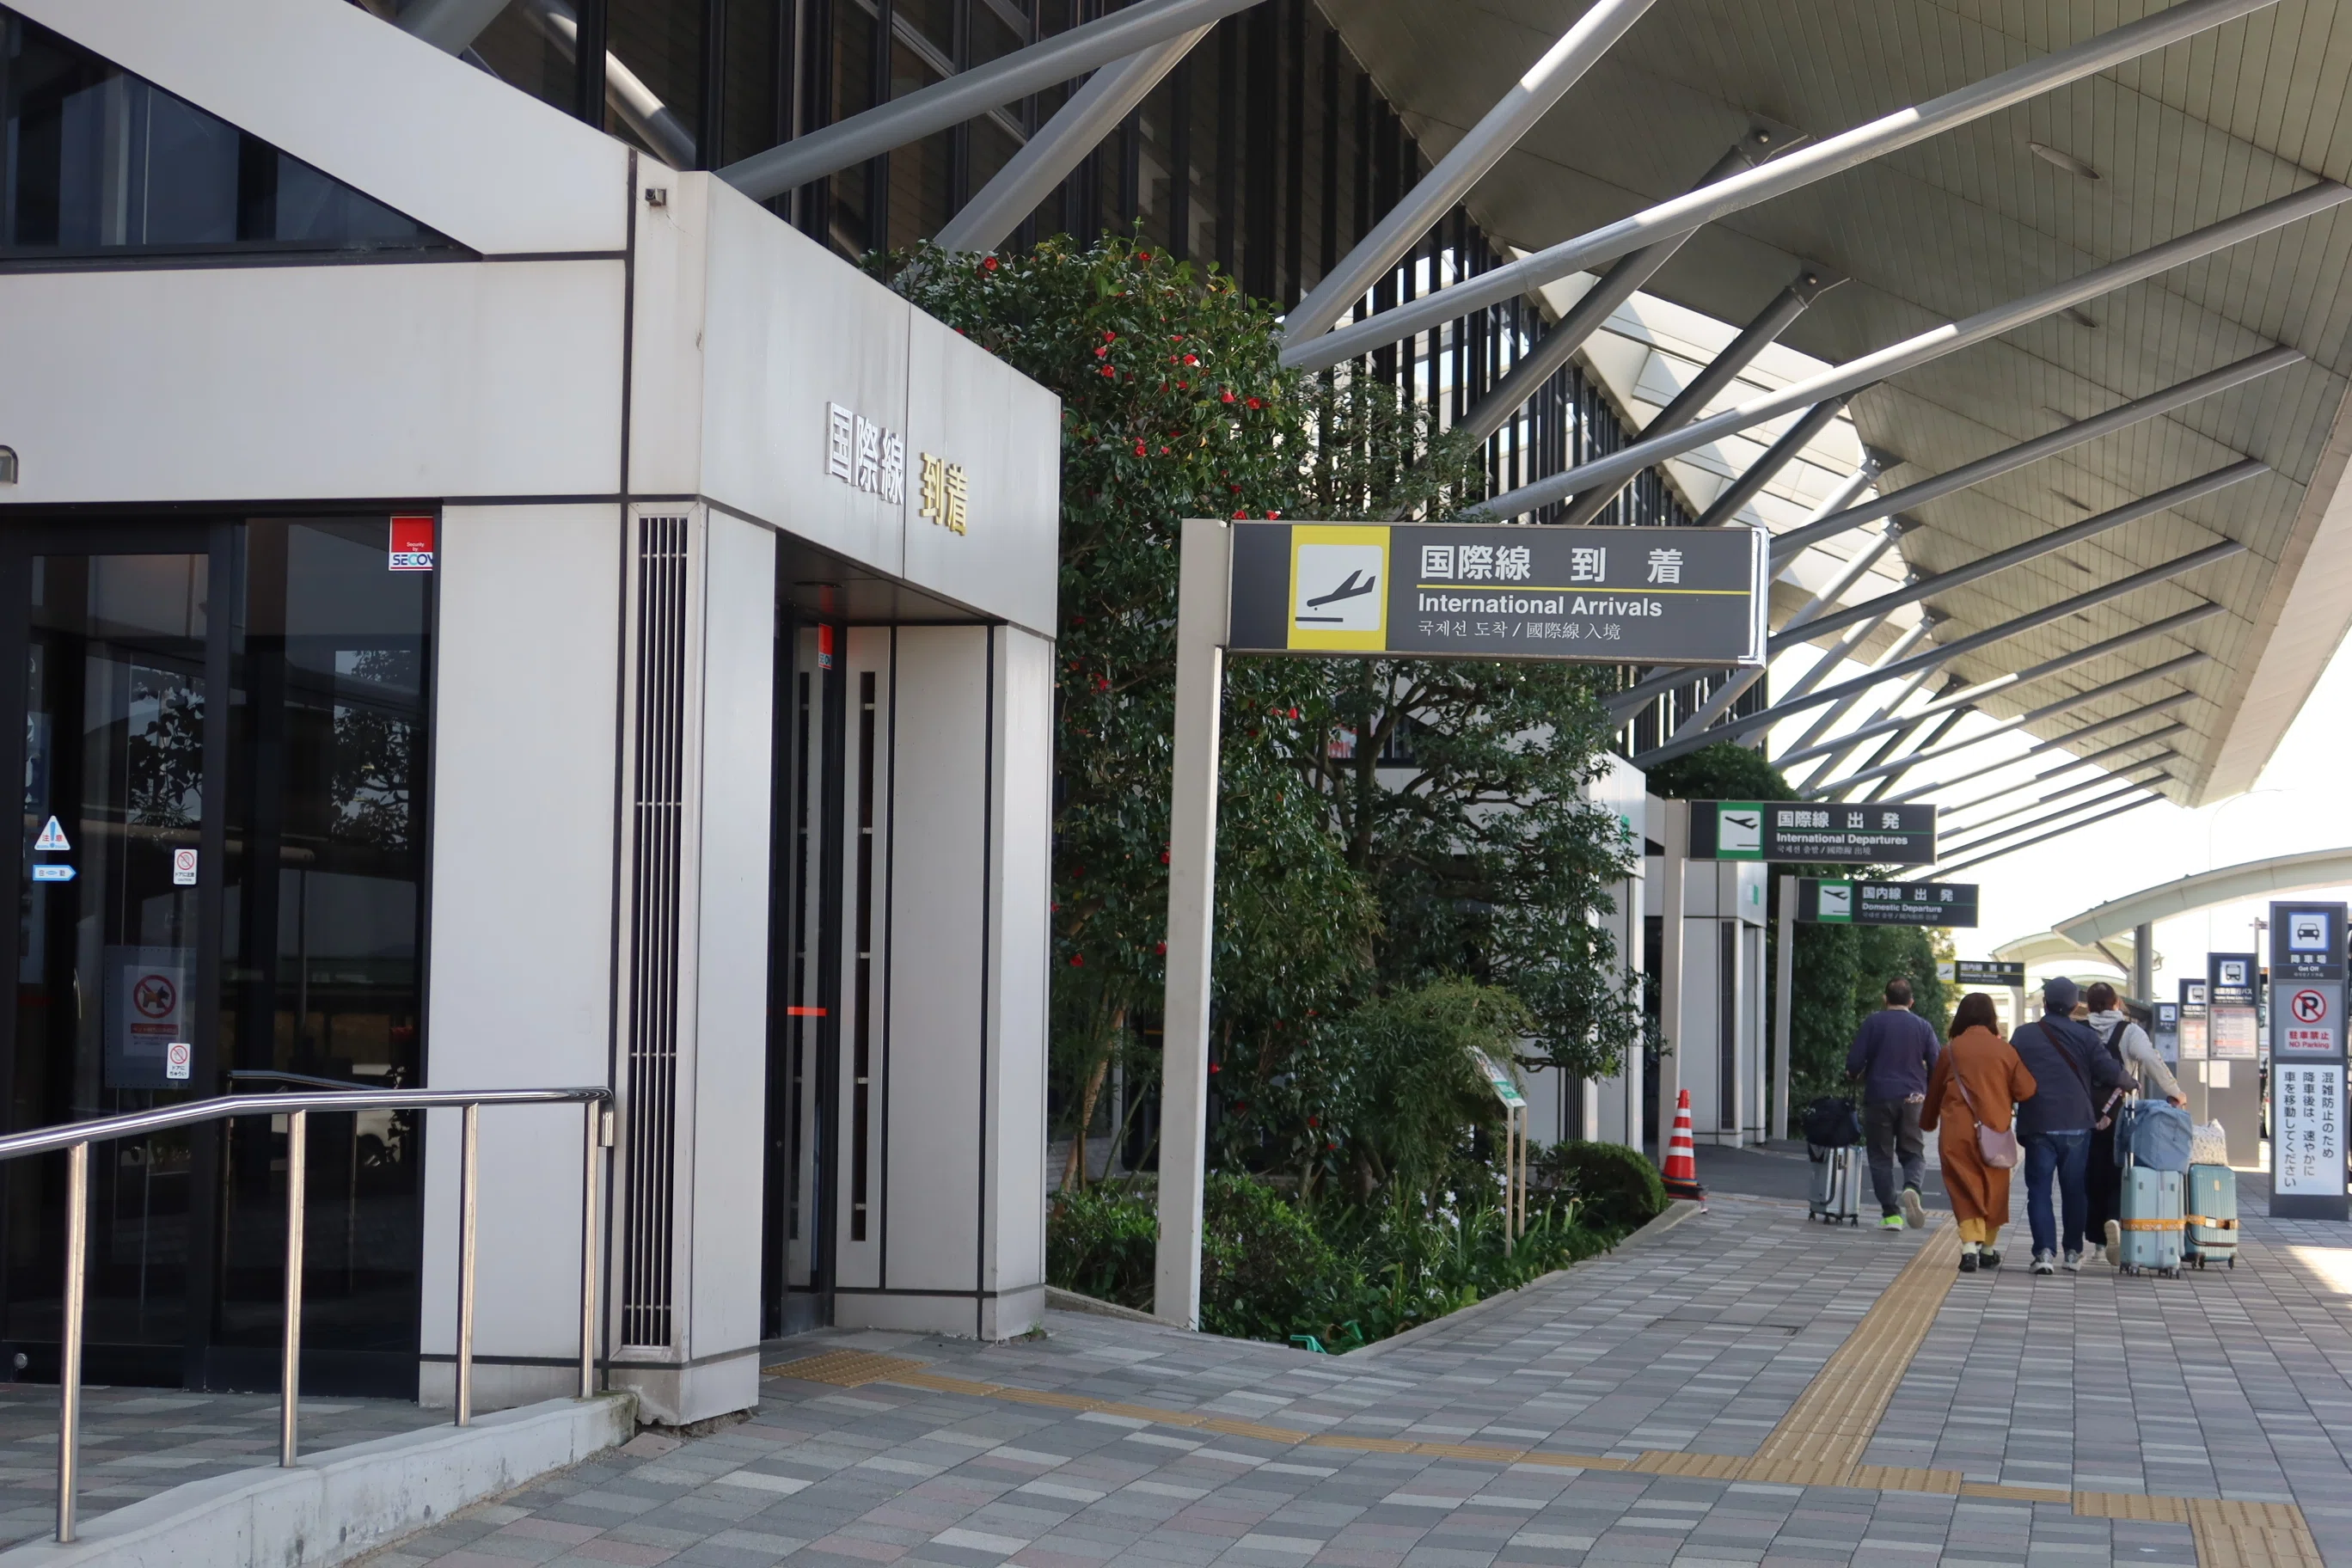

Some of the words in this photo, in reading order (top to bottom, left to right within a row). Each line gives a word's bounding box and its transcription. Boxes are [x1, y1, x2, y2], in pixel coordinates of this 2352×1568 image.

[825, 401, 903, 505] 国際線
[919, 452, 968, 536] 到着
[1420, 545, 1531, 581] 国際線
[1418, 593, 1565, 615] International
[1571, 596, 1663, 616] Arrivals
[1418, 620, 1467, 637] 국제선
[1474, 621, 1509, 639] 도착
[1527, 622, 1580, 640] 國際線
[1584, 622, 1621, 640] 入境
[1777, 811, 1829, 829] 国際線
[1776, 832, 1845, 844] International
[1848, 834, 1908, 847] Departures
[1862, 885, 1902, 901] 国内線
[1862, 903, 1901, 911] Domestic
[1902, 903, 1943, 913] Departure
[2289, 1031, 2330, 1040] 駐車禁止
[2302, 1041, 2330, 1050] Parking
[2321, 1071, 2334, 1158] 混雑防止のため
[2283, 1071, 2296, 1187] 車を移動してください
